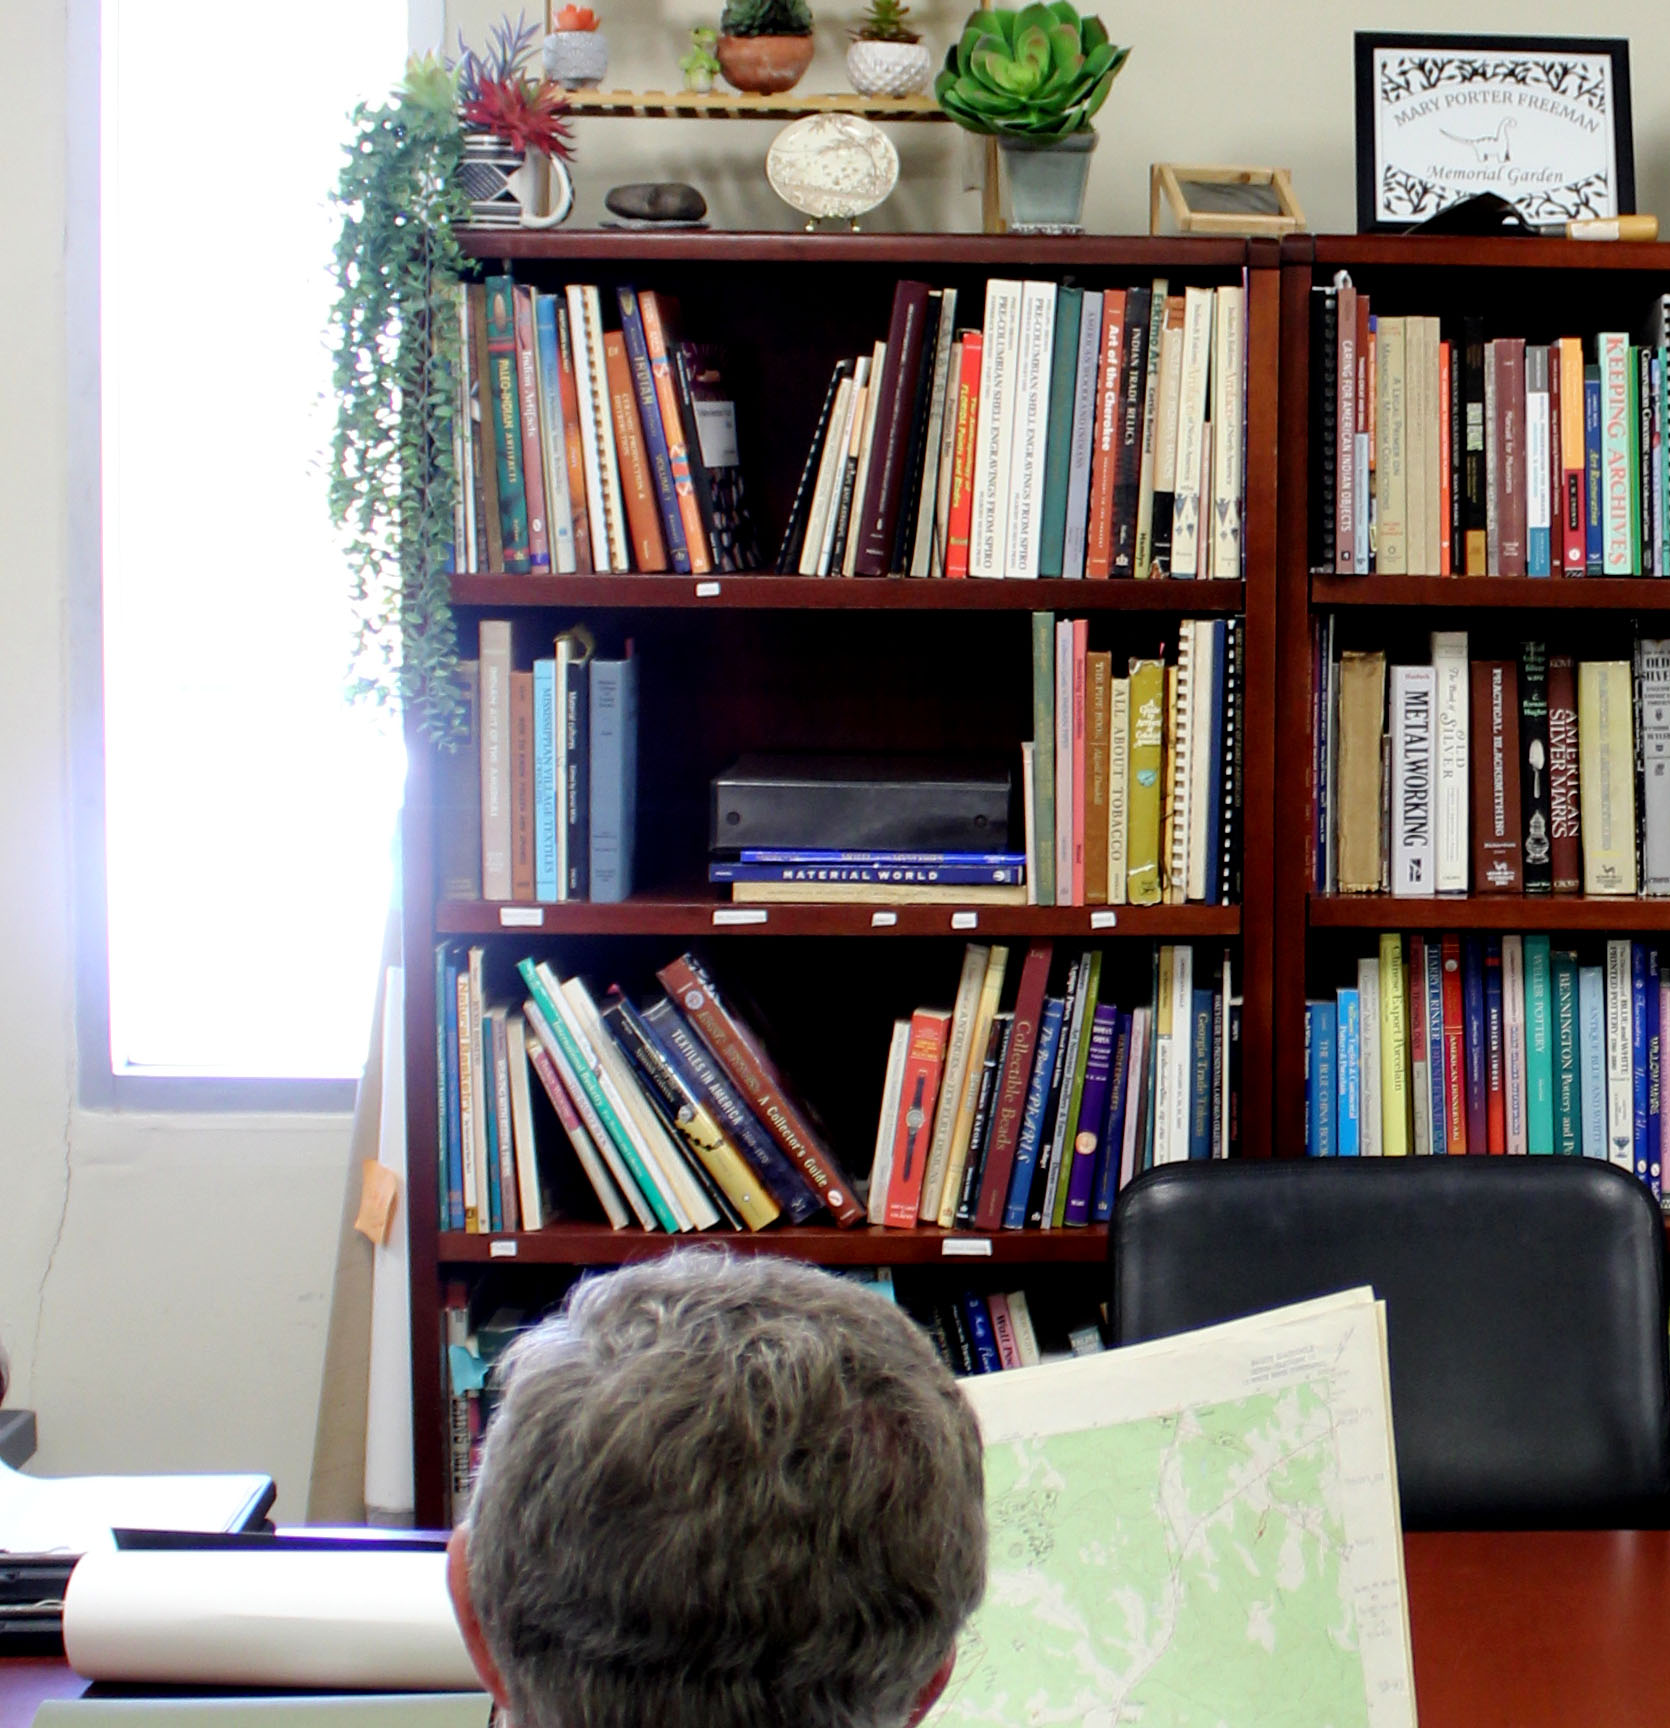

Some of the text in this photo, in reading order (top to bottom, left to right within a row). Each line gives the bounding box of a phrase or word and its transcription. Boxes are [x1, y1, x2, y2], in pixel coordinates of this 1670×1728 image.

[1394, 89, 1600, 134] MARY PORTER FREEMAN
[1425, 165, 1563, 186] Memorial Garden
[1102, 324, 1119, 452] Art of the Cherokee
[1128, 327, 1140, 404] INDIAN TRADE
[1149, 292, 1163, 376] Eskimo Art
[523, 351, 536, 439] Indian Artifacts
[983, 295, 1008, 569] PRE-COLUMBIAN SHELL ENGRAVINGS FROM SPIRO
[1019, 297, 1044, 570] PRE-COLUMBIAN SHELL ENGRAVINGS FROM SPIRO
[1340, 340, 1353, 533] CARING FOR AMERICAN INDIAN OBJECTS
[1606, 336, 1626, 566] KEEPING ARCHIVES
[1504, 410, 1514, 494] Manual for Museums
[1110, 688, 1125, 862] ALL ABOUT TOBACCO
[1403, 690, 1430, 848] METALWORKING
[1440, 712, 1457, 781] SILVER
[1492, 667, 1504, 837] PRACTICAL BLACKSMITHING
[1550, 708, 1566, 839] SILVER MARKS
[1566, 710, 1579, 838] AMERICAN
[782, 870, 939, 881] MATERIAL WORLD
[458, 982, 472, 1115] Natural Basketry
[1195, 1011, 1207, 1094] Georgia Trade
[1392, 945, 1404, 1092] Chinese Export Porcelain
[1429, 1001, 1440, 1040] RINKER
[1535, 1001, 1545, 1054] POTTERY
[1559, 973, 1573, 1138] BENNINGTON Pottery and
[670, 1027, 702, 1074] TEXTILES
[700, 1069, 713, 1085] IN
[707, 1078, 745, 1126] AMERICA
[994, 1019, 1033, 1152] Collectible Beads
[1319, 1091, 1329, 1124] CHINA
[757, 1094, 829, 1188] A Collector's Guide
